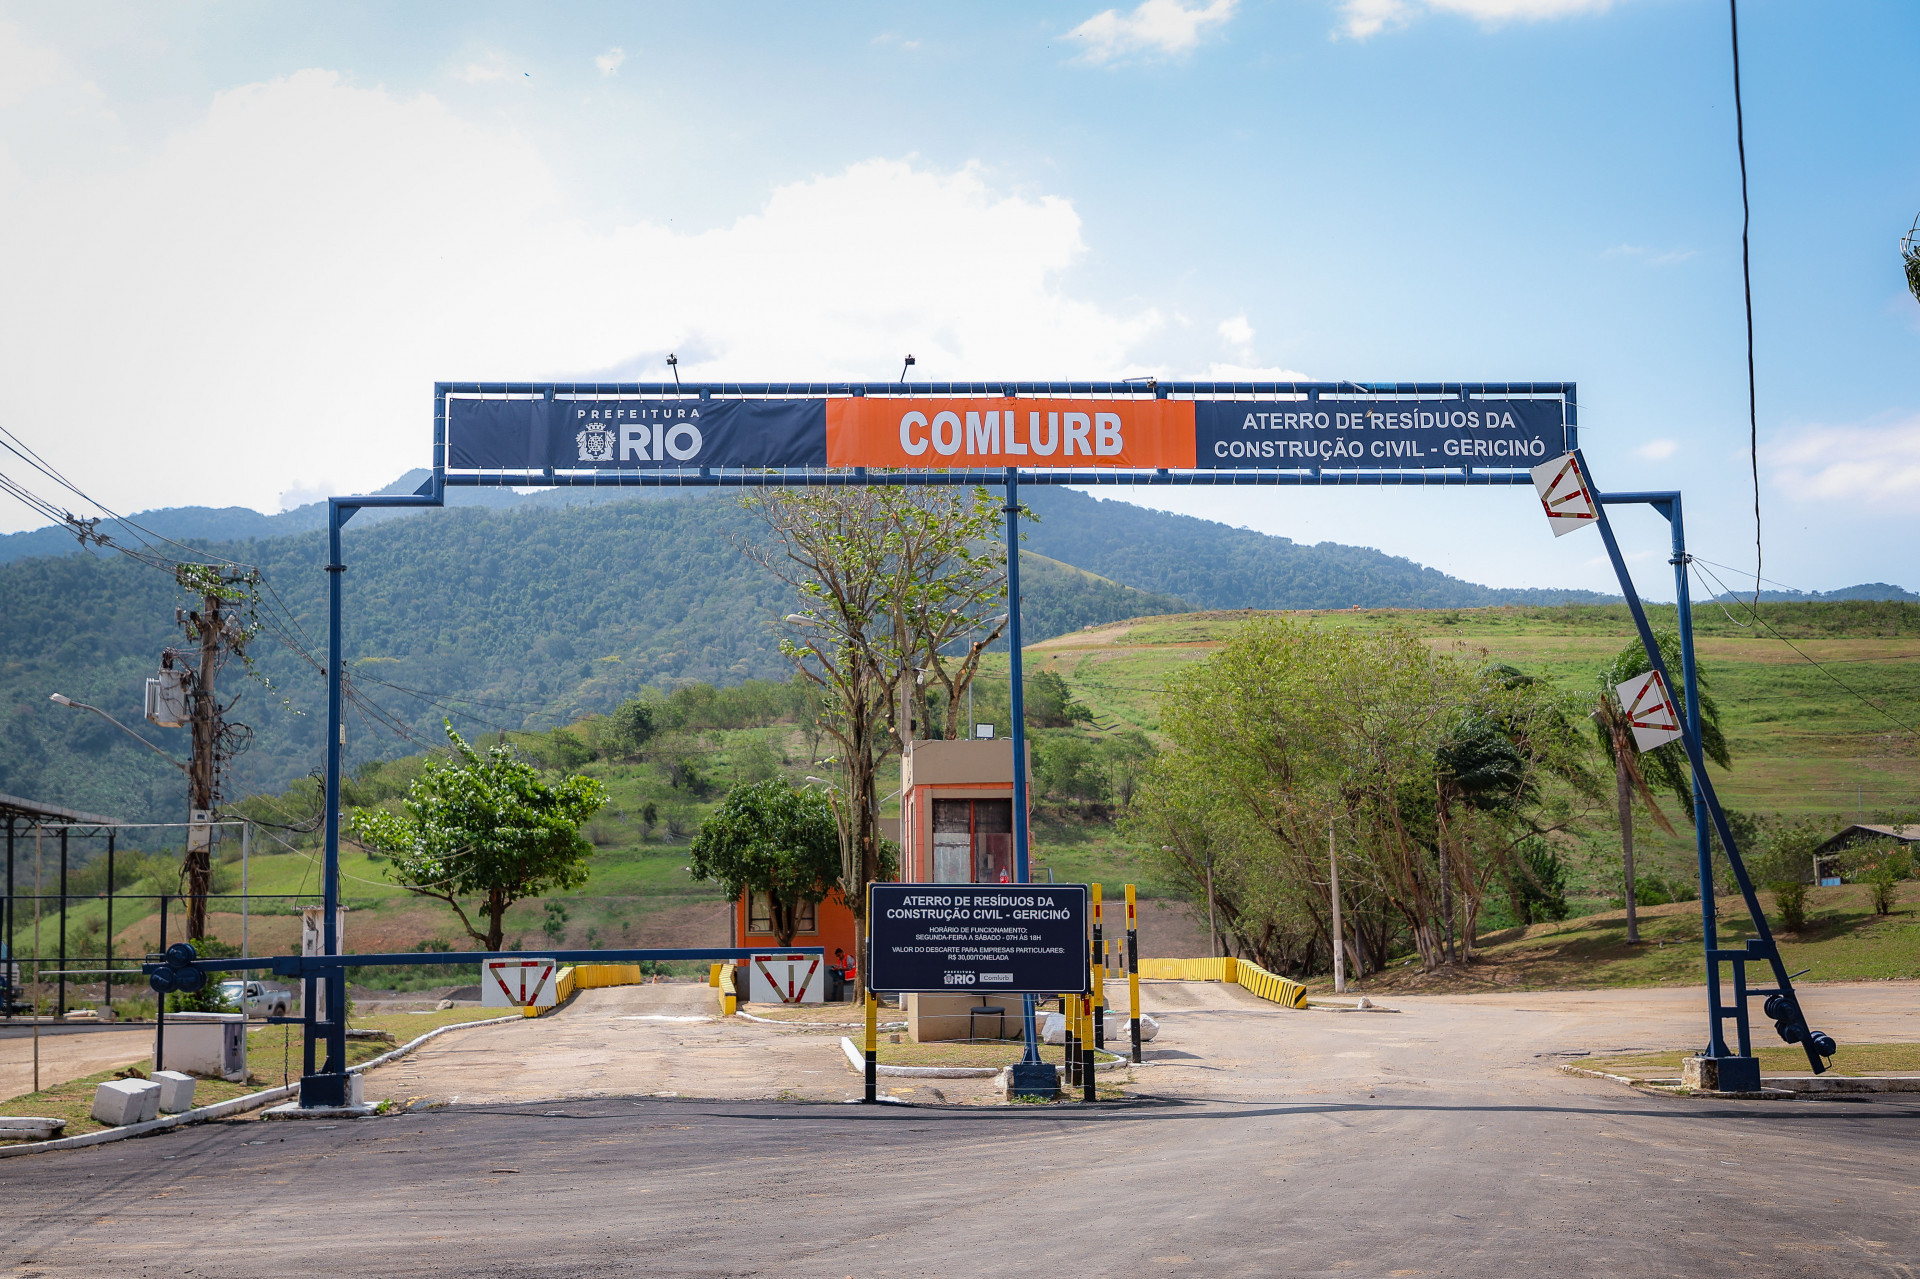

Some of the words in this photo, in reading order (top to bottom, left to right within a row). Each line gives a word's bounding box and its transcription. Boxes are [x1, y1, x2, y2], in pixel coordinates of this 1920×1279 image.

[578, 408, 700, 419] PREFEITURA
[1243, 412, 1330, 430] ATERRO
[1336, 412, 1364, 430] DE
[1370, 408, 1479, 430] RESÍDUOS
[1486, 412, 1515, 429] DA
[899, 410, 1123, 456] COMLURB
[619, 423, 703, 461] RIO
[1214, 437, 1364, 461] CONSTRUÇÃO
[1370, 440, 1424, 457] CIVIL
[1444, 436, 1545, 457] GERICINÓ
[903, 896, 951, 906] ATERRO
[954, 896, 970, 906] DE
[974, 894, 1034, 907] RESÍDUOS
[1038, 896, 1054, 906] DA
[887, 907, 970, 921] CONSTRUÇÃO
[973, 909, 1003, 920] CIVIL
[1013, 907, 1070, 920] GERICINÓ
[975, 933, 1001, 941] SÁBADO
[1018, 933, 1028, 941] ÀS
[954, 973, 975, 985] RIO
